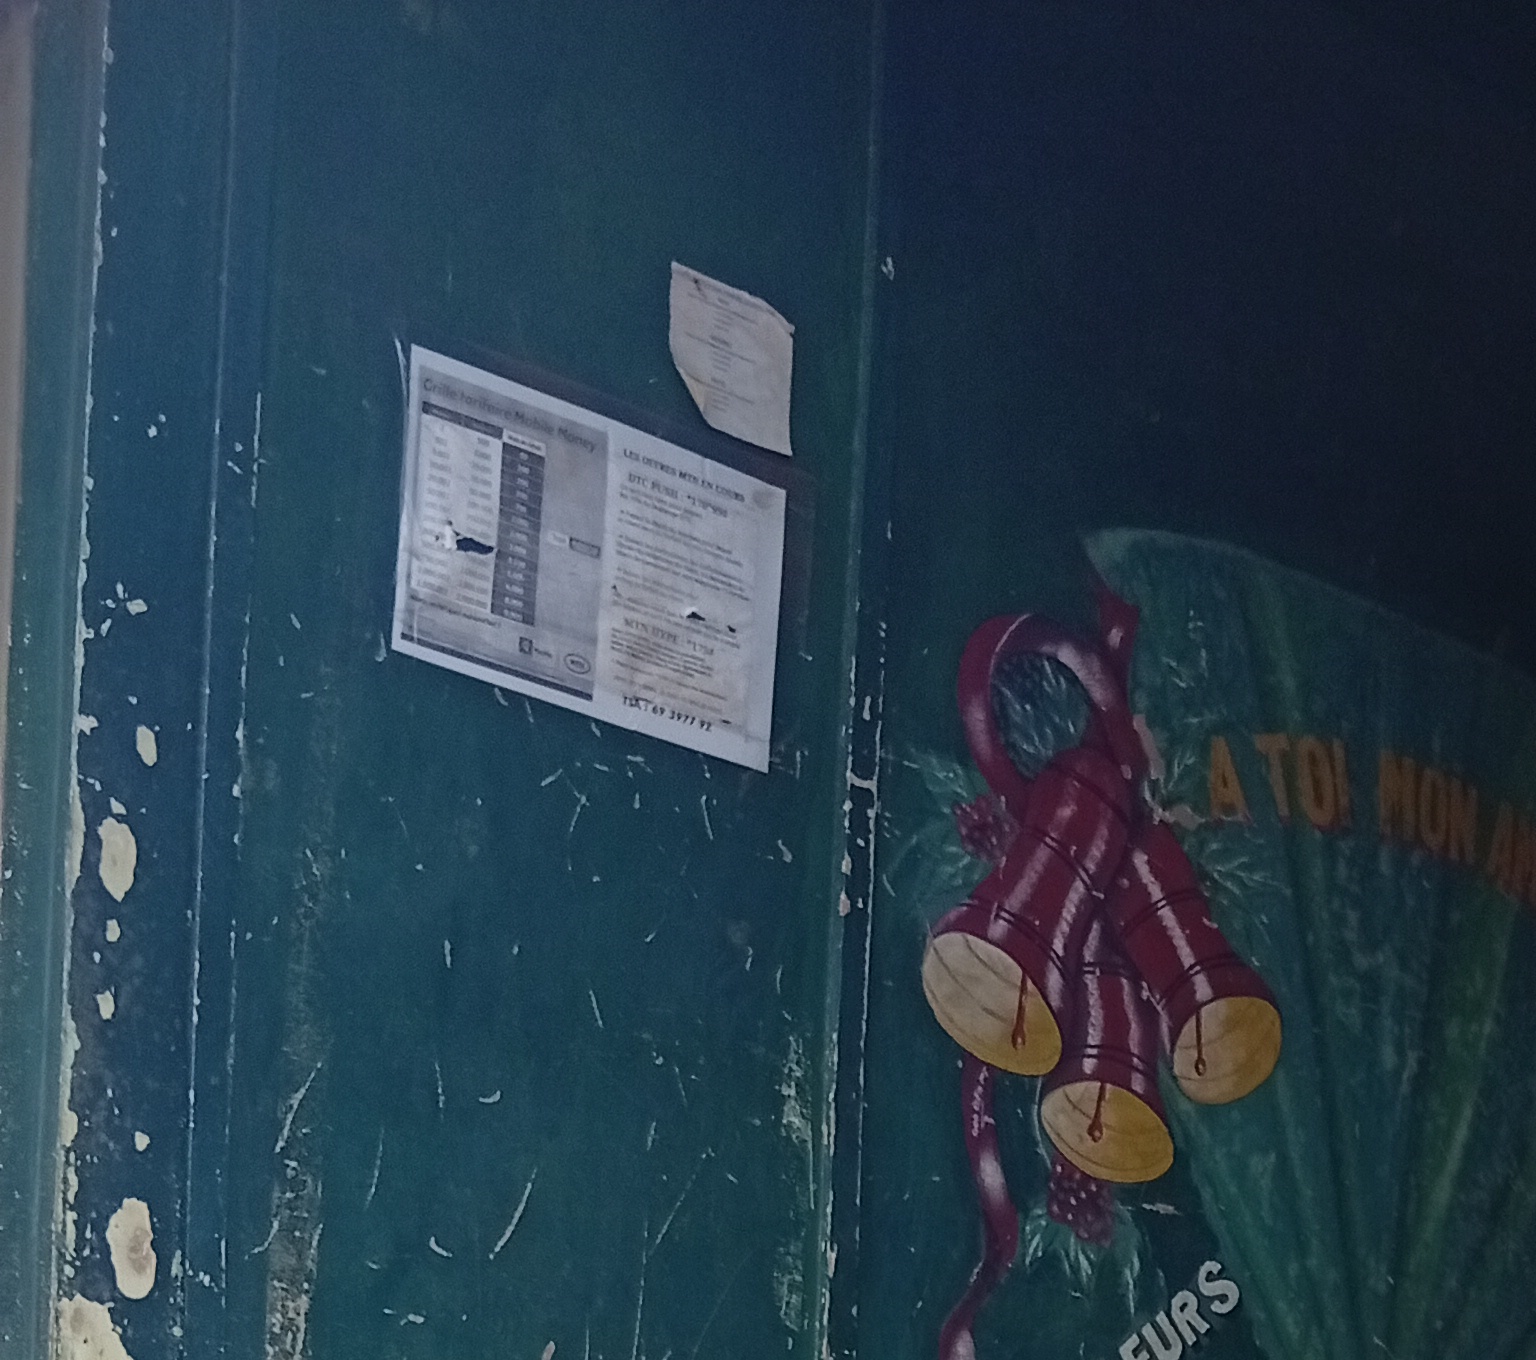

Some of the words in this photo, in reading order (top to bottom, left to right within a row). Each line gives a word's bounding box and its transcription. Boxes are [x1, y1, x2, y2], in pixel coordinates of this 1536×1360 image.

[1208, 735, 1253, 827] A
[1253, 732, 1353, 832] TOI
[1378, 748, 1480, 866] MON
